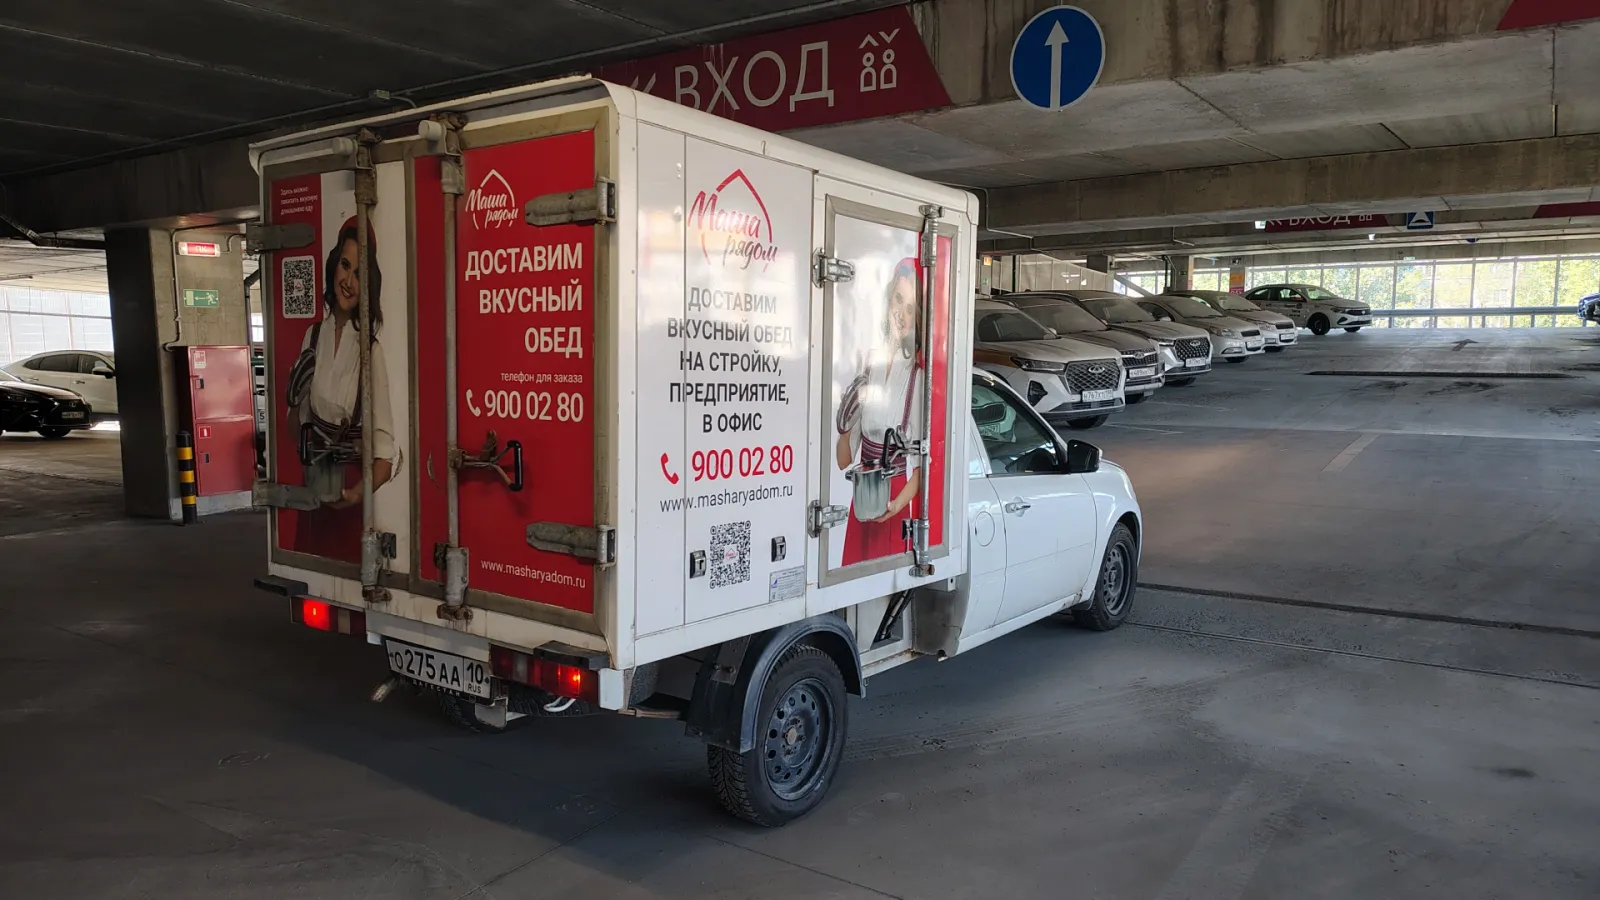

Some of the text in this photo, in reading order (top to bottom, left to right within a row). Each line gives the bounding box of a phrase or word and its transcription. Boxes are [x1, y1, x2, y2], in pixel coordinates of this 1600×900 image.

[674, 40, 834, 113] ВХОД
[465, 188, 508, 212] Маша
[688, 190, 761, 238] Маша
[484, 208, 519, 229] рядом
[465, 242, 583, 281] ДОСТАВИМ
[722, 235, 778, 270] рядом
[479, 278, 583, 314] ВКУСНЫЙ
[688, 287, 777, 315] ДОСТАВИМ
[524, 326, 583, 359] ОБЕД
[667, 317, 793, 349] ВКУСНЫЙ ОБЕД
[680, 350, 783, 376] НА СТРОЙКУ,
[501, 371, 583, 384] телефон для заказа
[484, 389, 584, 422] 900 02 80
[669, 382, 790, 406] ПРЕДПРИЯТИЕ,
[703, 412, 763, 433] В ОФИС
[691, 444, 794, 482] 900 02 80
[659, 484, 793, 512] www.masharyadom.ru
[480, 560, 586, 589] www.masharyadom.ru
[466, 662, 484, 685] 10
[468, 683, 482, 694] RUS
